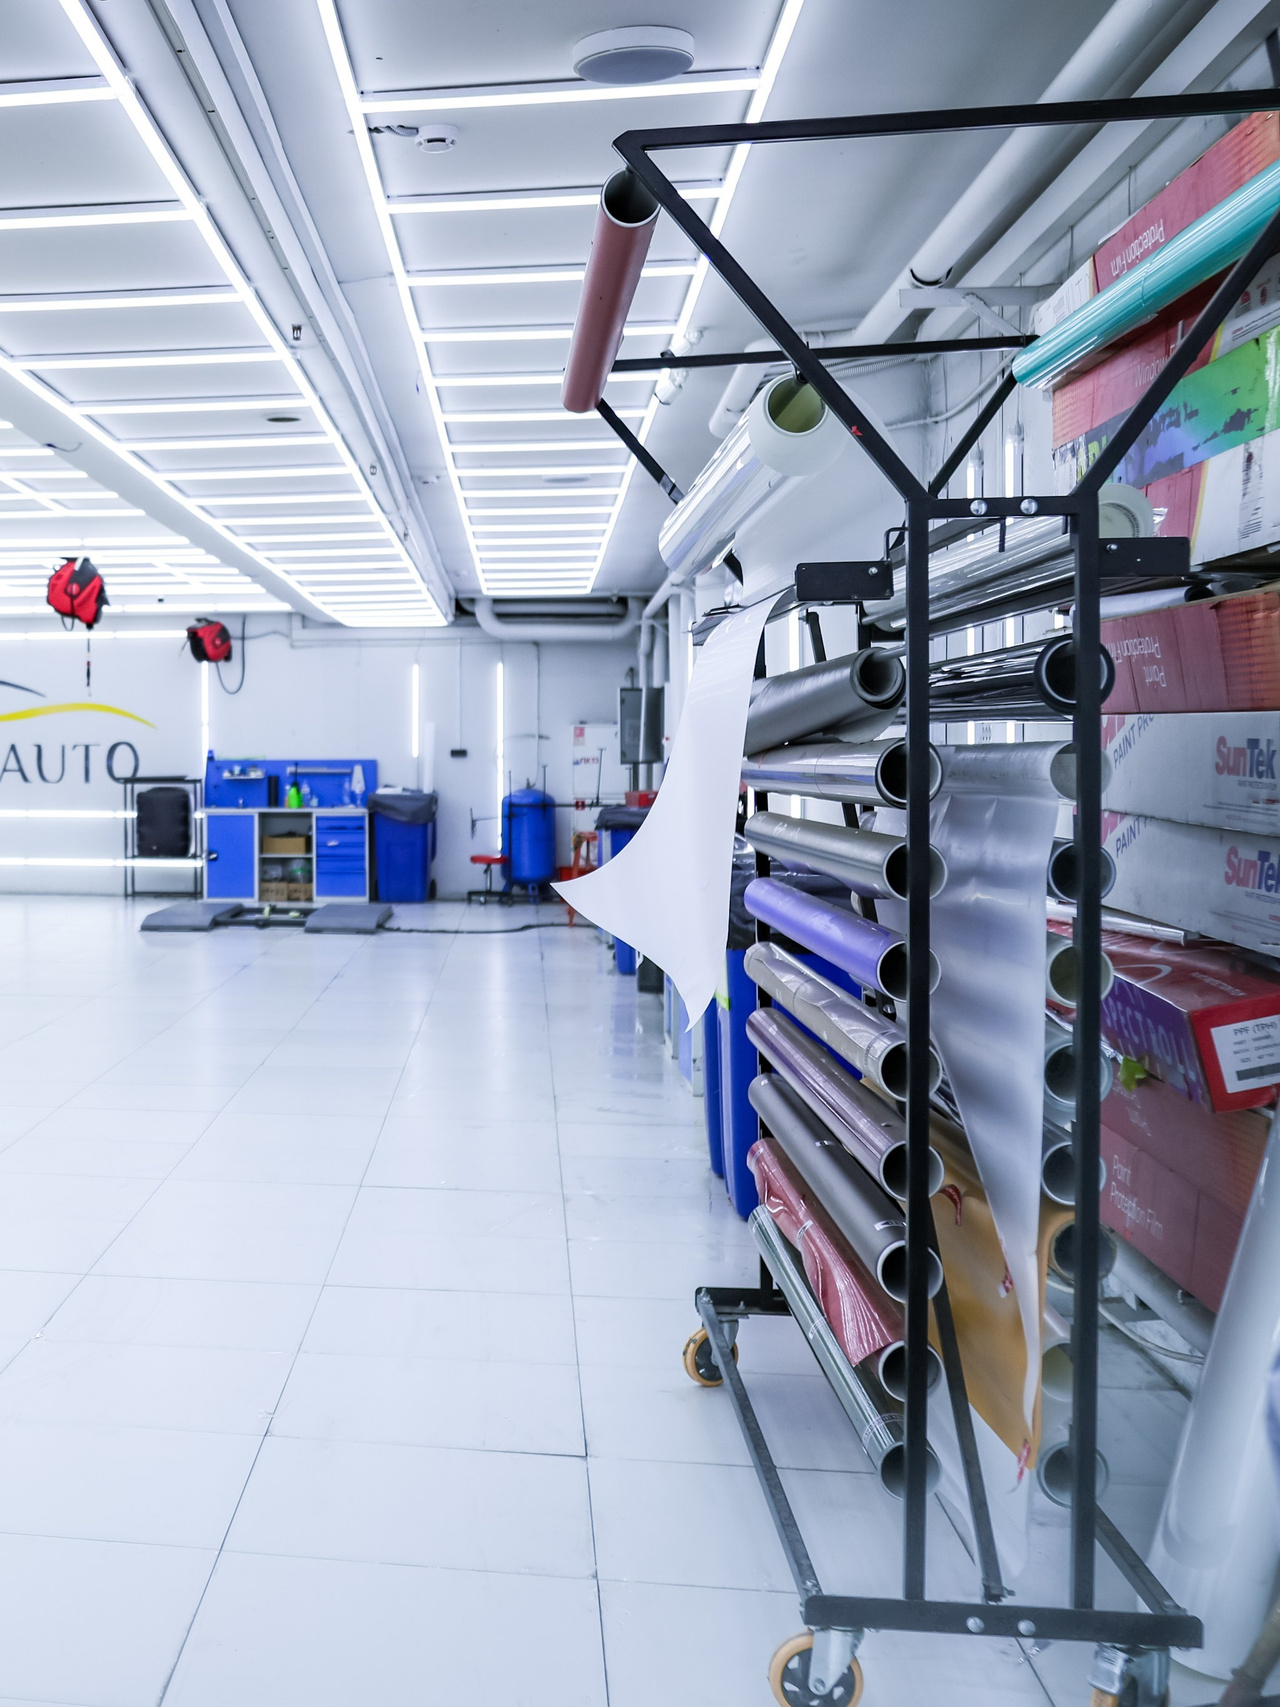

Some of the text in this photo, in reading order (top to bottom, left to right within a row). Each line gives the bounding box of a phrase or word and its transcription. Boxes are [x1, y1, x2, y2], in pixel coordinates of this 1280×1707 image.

[1113, 722, 1136, 770] PAINT
[1214, 735, 1277, 780] SunTek
[1115, 816, 1141, 859] PAINT
